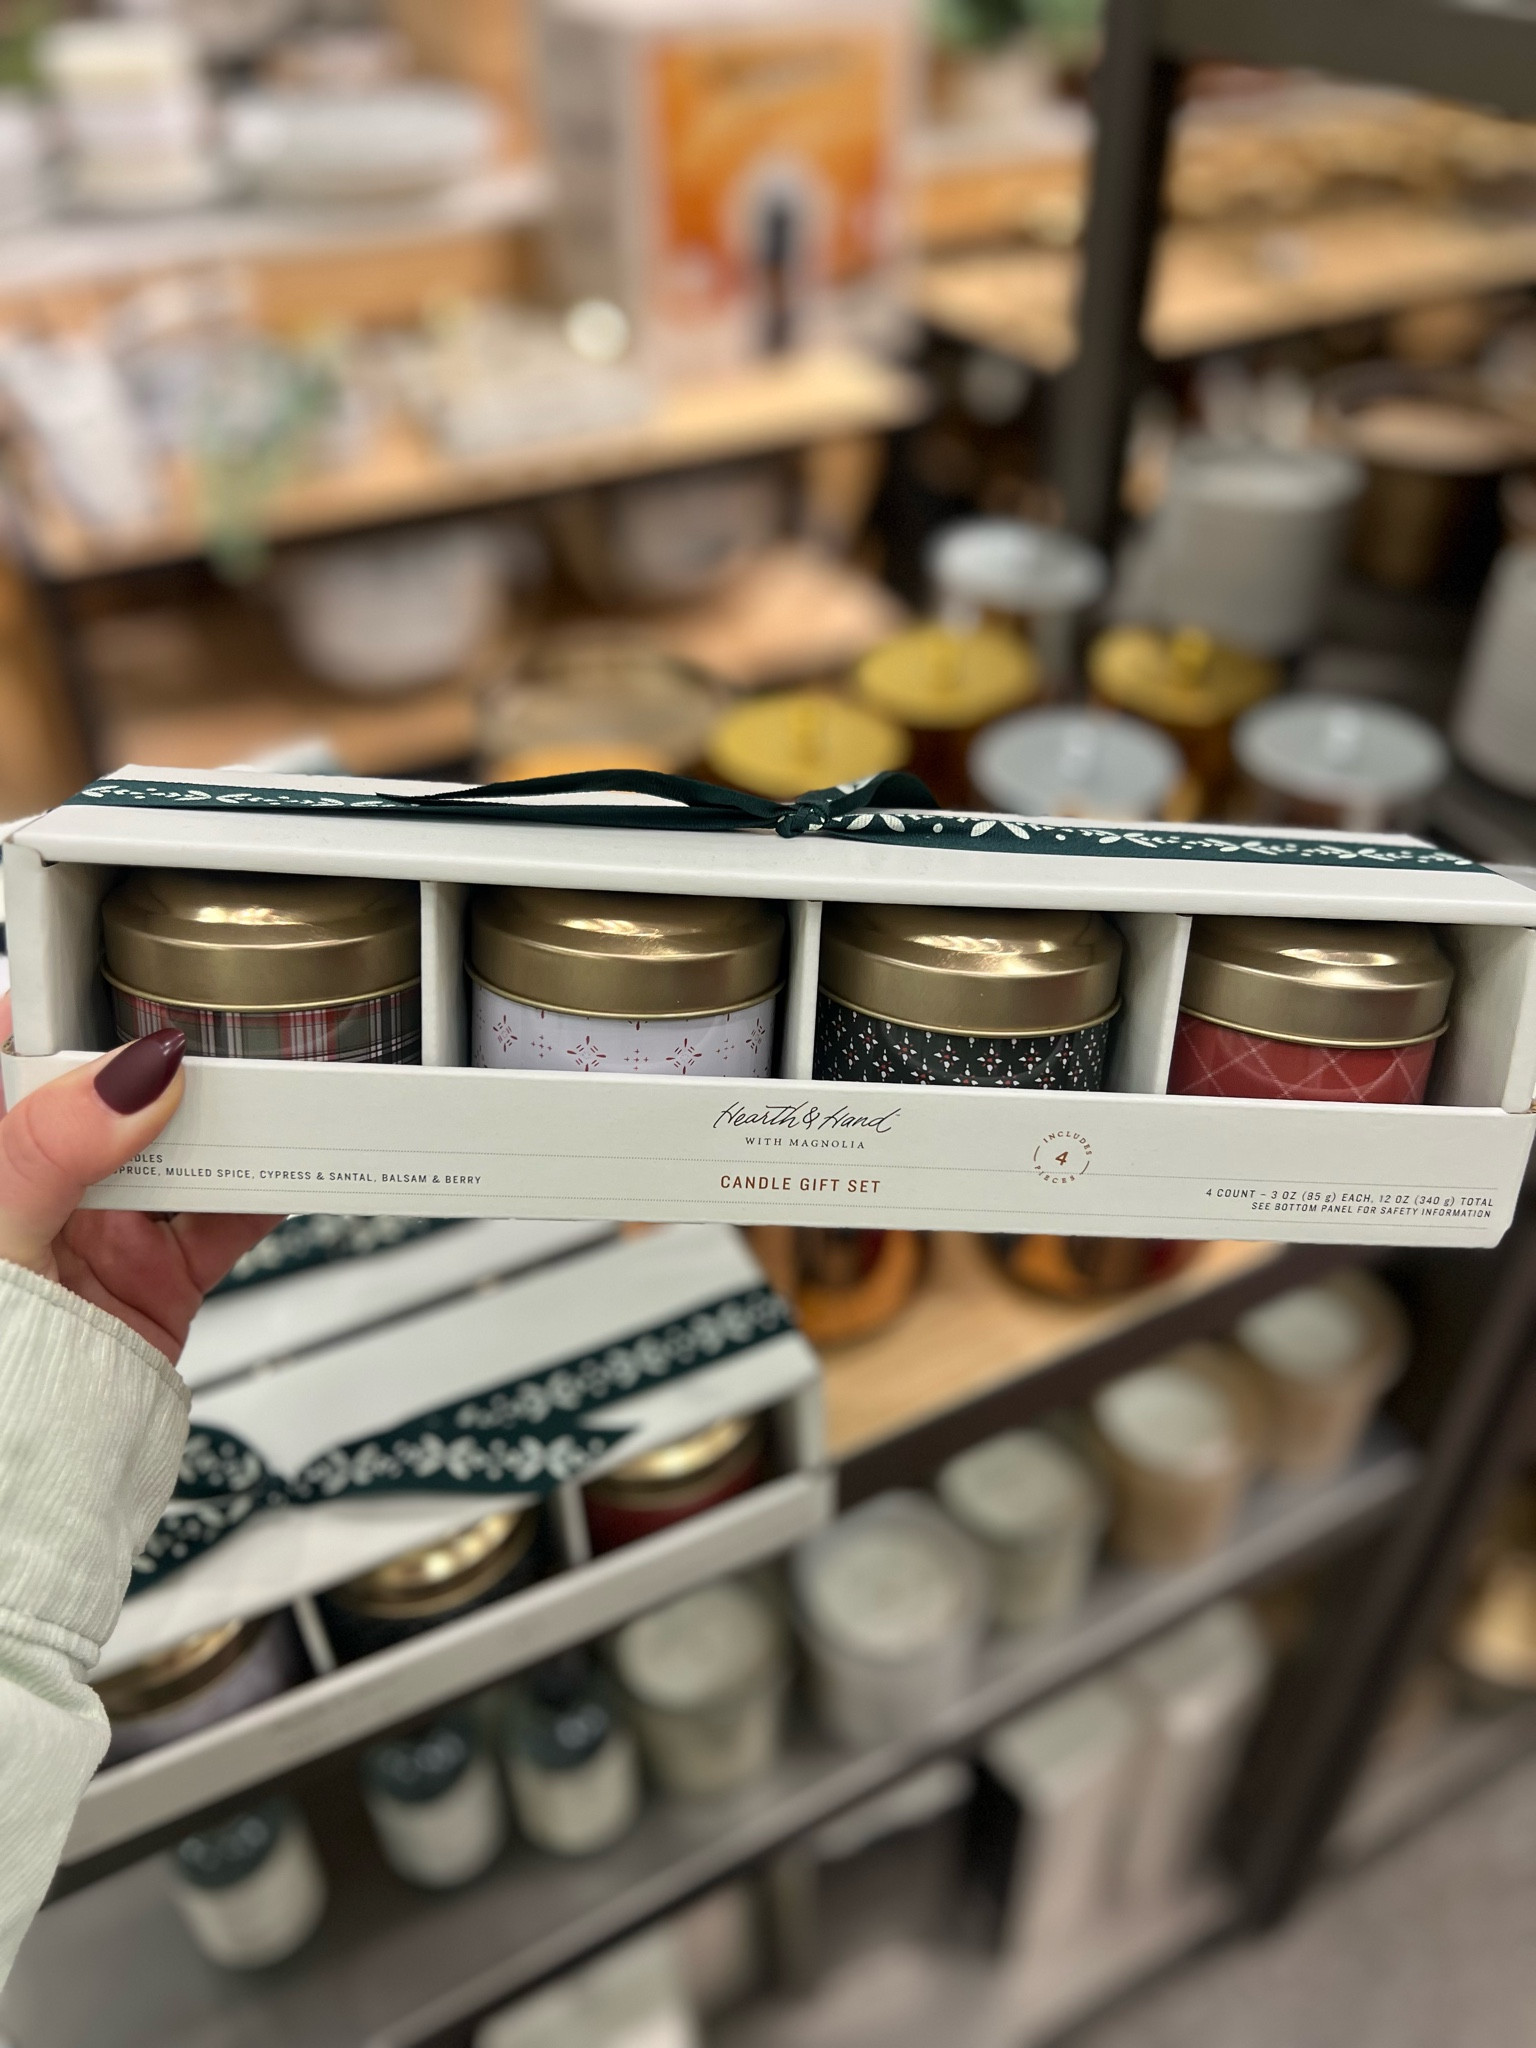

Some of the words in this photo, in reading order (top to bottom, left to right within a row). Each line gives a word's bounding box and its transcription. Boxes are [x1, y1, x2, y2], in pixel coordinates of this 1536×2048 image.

[712, 1101, 809, 1128] Hearth
[801, 1106, 820, 1130] &
[745, 1137, 783, 1147] WITH
[789, 1138, 865, 1149] MAGNOLIA
[1043, 1131, 1092, 1155] INCLUDES
[129, 1154, 163, 1163] DLES
[1055, 1151, 1069, 1166] 4
[166, 1167, 212, 1178] MULLED
[217, 1169, 255, 1180] SPICE,
[259, 1170, 311, 1181] CYPRESS
[316, 1172, 325, 1181] &
[329, 1172, 377, 1183] SANTAL,
[382, 1173, 427, 1184] BALSAM
[432, 1175, 441, 1184] &
[445, 1175, 481, 1185] BERRY
[1034, 1165, 1075, 1184] PIECES
[720, 1175, 792, 1190] CANDLE
[799, 1178, 840, 1192] GIFT
[847, 1179, 881, 1193] SET
[1206, 1188, 1212, 1197] 4
[1216, 1188, 1256, 1199] COUNT
[1271, 1190, 1278, 1200] 3
[1282, 1191, 1297, 1200] OZ
[1341, 1193, 1374, 1204] EACH,
[1379, 1194, 1391, 1204] 12
[1395, 1194, 1410, 1204] OZ
[1414, 1195, 1440, 1206] (340
[1460, 1197, 1494, 1207] TOTAL
[1251, 1201, 1271, 1211] SEE
[1274, 1203, 1317, 1212] BOTTOM
[1320, 1204, 1353, 1214] PANEL
[1357, 1205, 1377, 1215] FOR
[1380, 1206, 1418, 1216] SAFETY
[1421, 1208, 1492, 1218] INFORMATION
